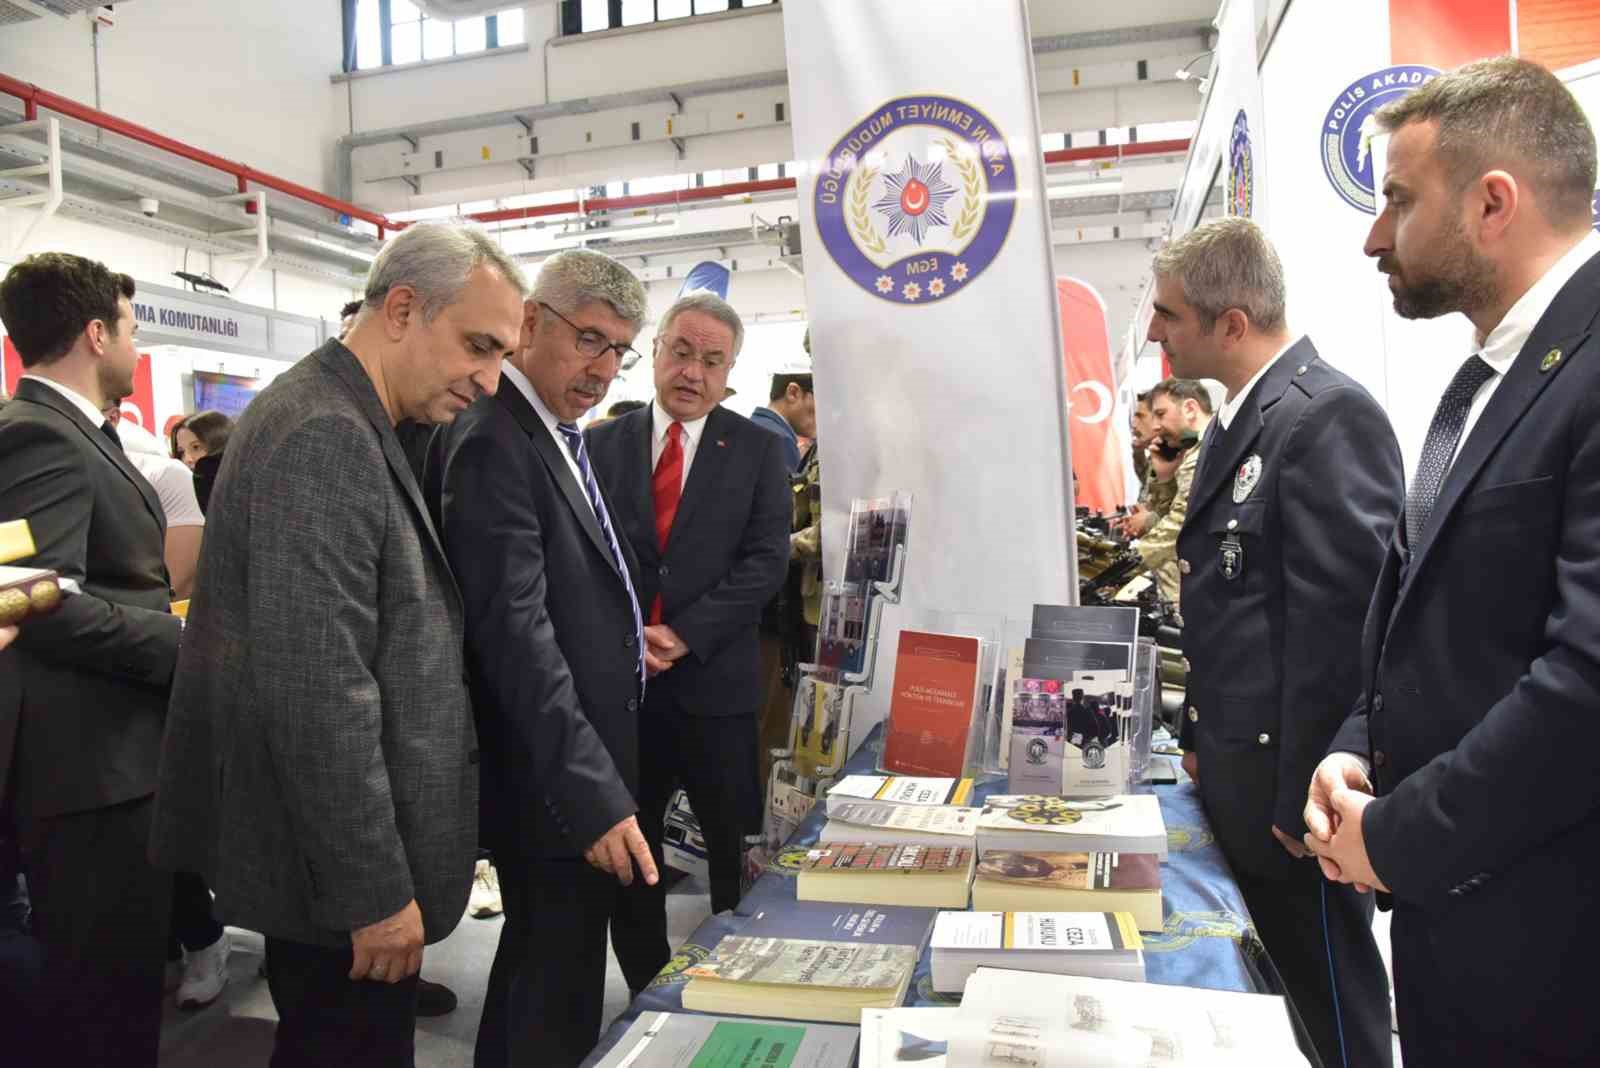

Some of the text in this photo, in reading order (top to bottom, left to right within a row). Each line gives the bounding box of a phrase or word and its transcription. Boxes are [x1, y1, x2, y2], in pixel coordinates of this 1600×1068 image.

[159, 307, 239, 338] KOMUTANLIĞI
[1039, 917, 1057, 946] HUKUKU
[1066, 927, 1084, 946] CEZA
